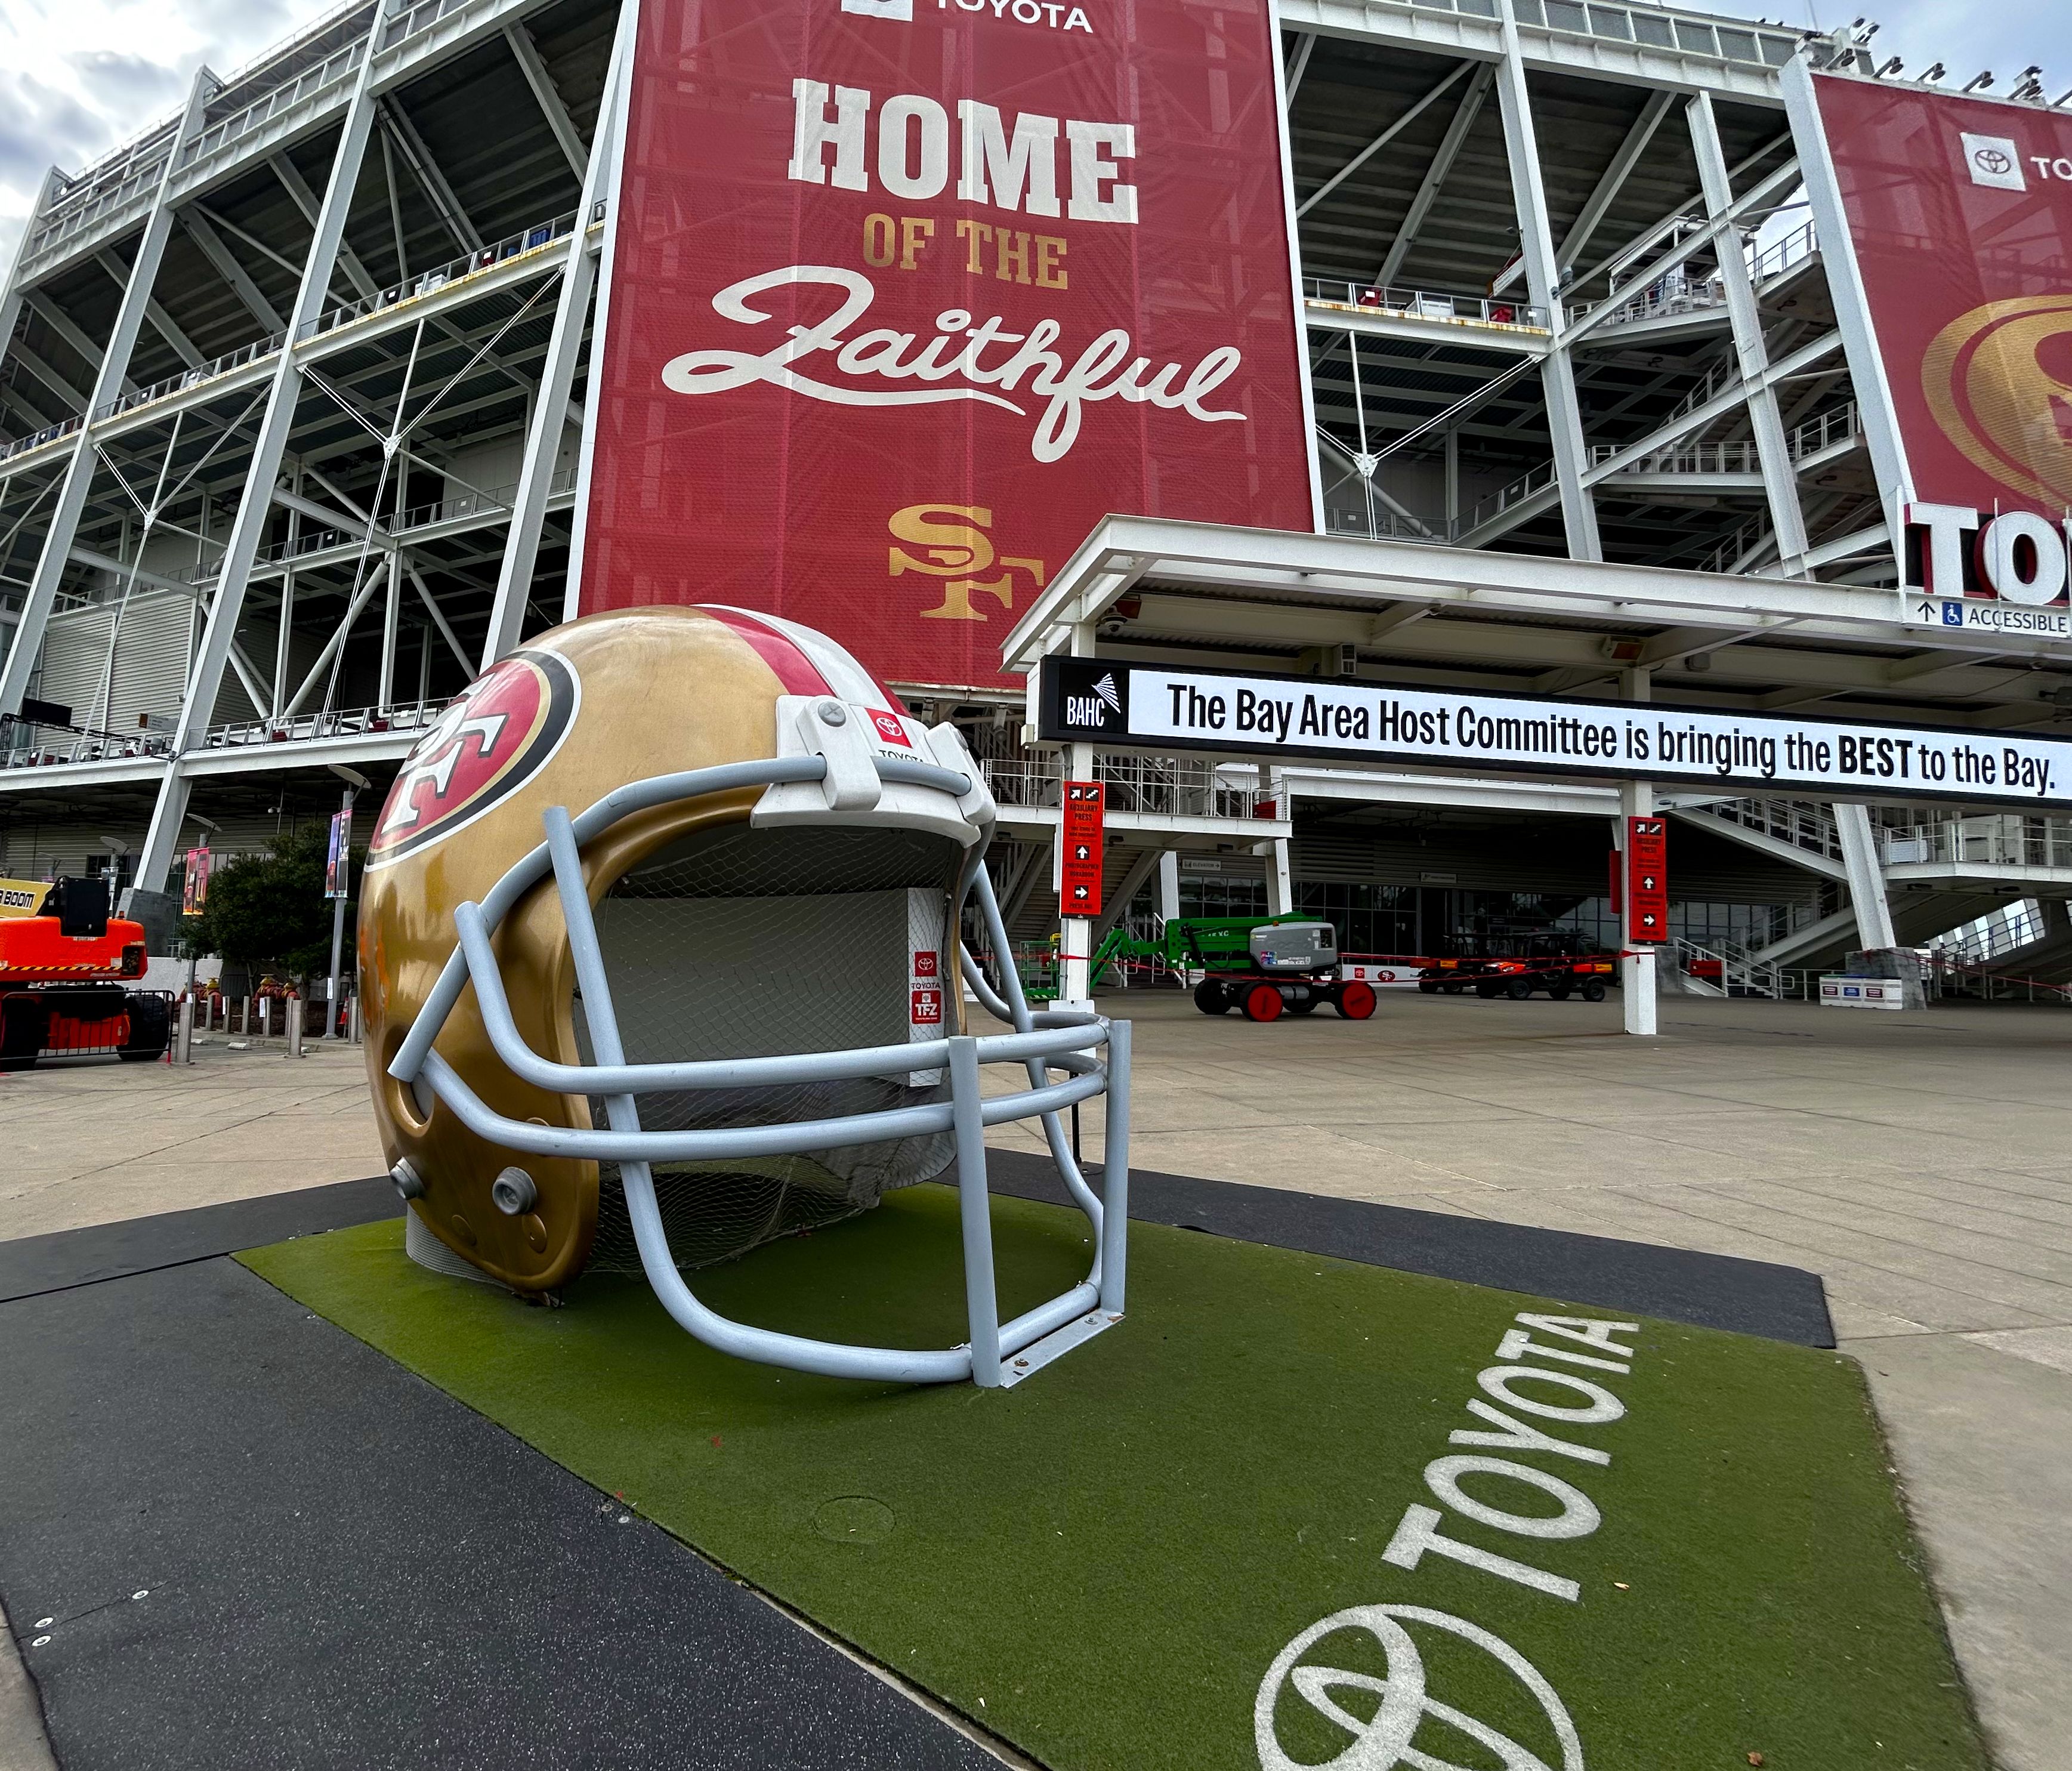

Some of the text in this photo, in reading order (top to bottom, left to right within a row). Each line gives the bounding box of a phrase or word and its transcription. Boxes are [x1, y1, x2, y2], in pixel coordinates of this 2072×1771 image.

[788, 78, 1138, 224] HOME
[863, 213, 1067, 289] OF THE
[661, 266, 1247, 463] Faithful
[1908, 502, 2072, 606] TO
[1969, 608, 2068, 632] ACCESSIBLE
[1067, 696, 1105, 727] BAHC
[1167, 684, 2055, 797] The Bay Area Host Committee is bringing the BEST to the Bay.
[4, 891, 35, 908] BOOM
[915, 1003, 938, 1016] TFZ
[1381, 1312, 1640, 1602] TOYOTA
